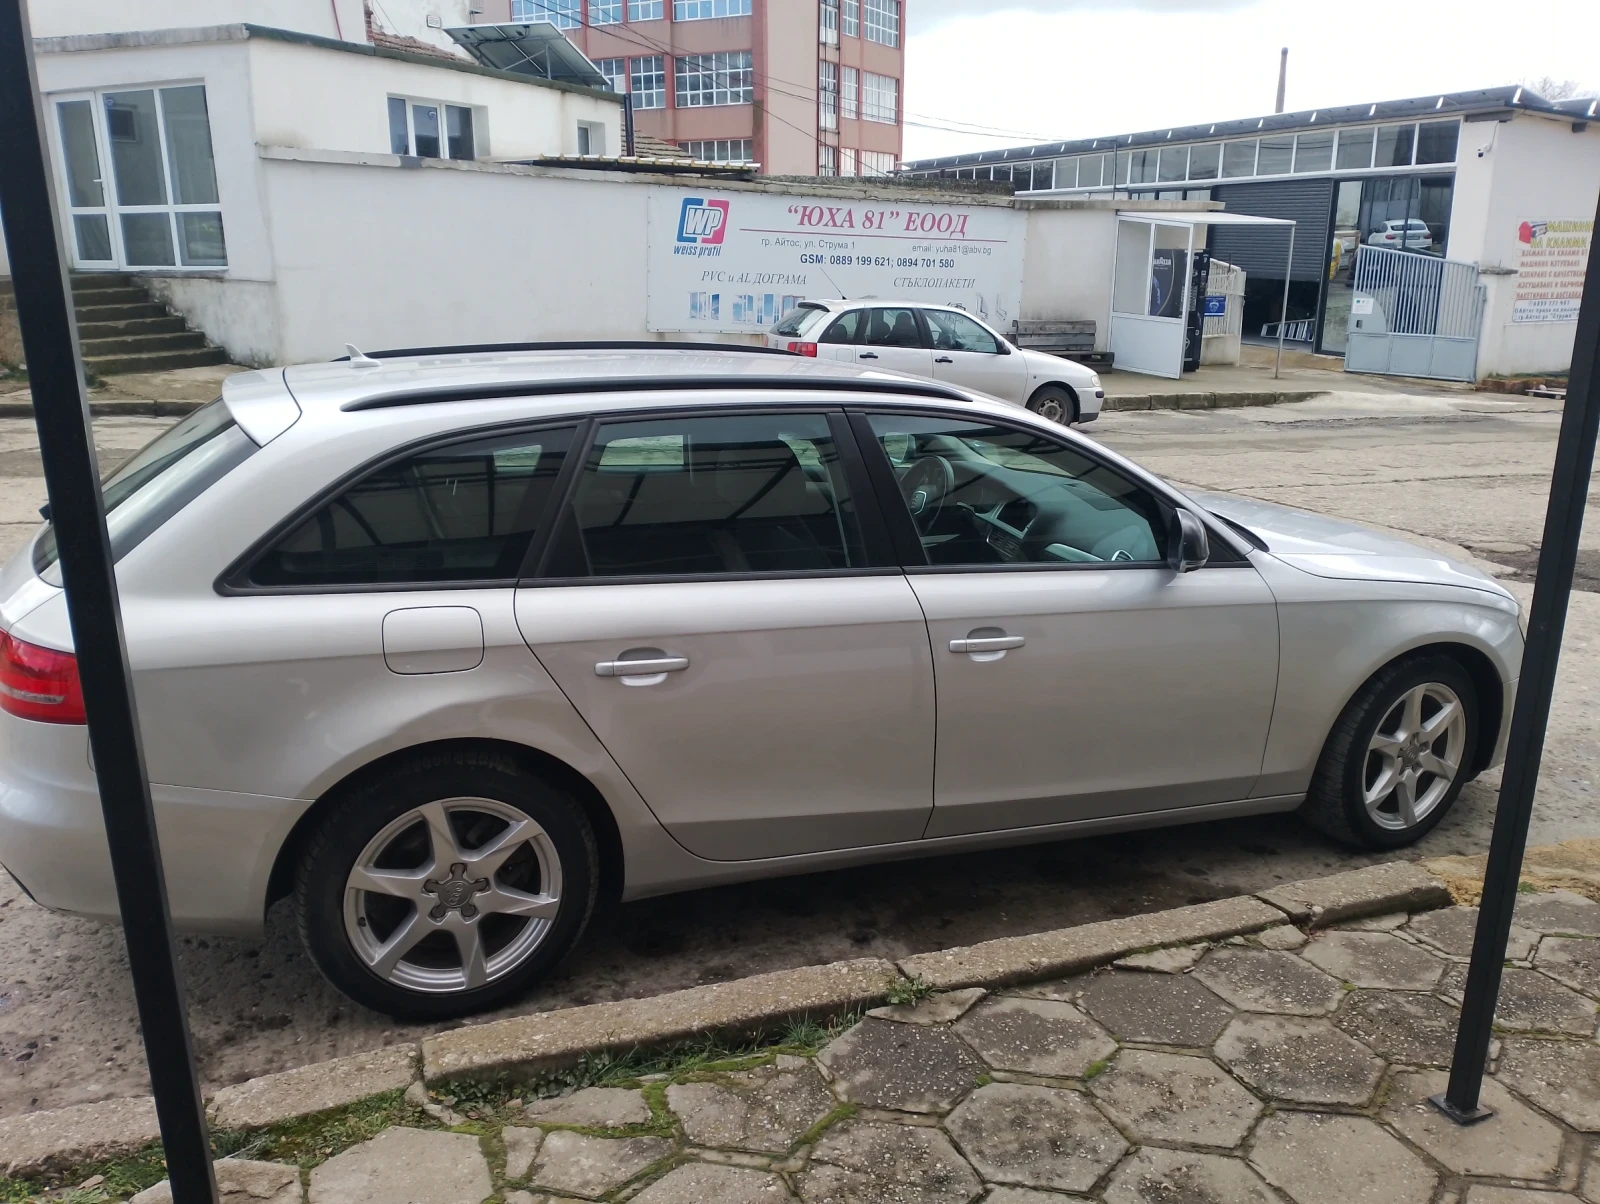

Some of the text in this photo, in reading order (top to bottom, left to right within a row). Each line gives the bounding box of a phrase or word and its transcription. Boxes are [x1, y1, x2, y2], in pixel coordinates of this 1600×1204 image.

[684, 206, 723, 236] WP
[903, 211, 970, 239] ЕООД
[673, 244, 722, 259] weiss profil
[761, 238, 773, 247] гр.
[804, 240, 816, 250] ул.
[818, 239, 849, 251] Струма
[851, 241, 856, 250] 1
[912, 244, 992, 256] email: yuha81@abv.bg
[800, 253, 955, 269] GSM: 0889 199 621; 0894 701 580
[701, 270, 726, 283] PVC
[736, 271, 752, 284] AL
[752, 272, 808, 286] ДОГРАМА
[893, 276, 976, 289] СТЪКЛОПАКЕТИ
